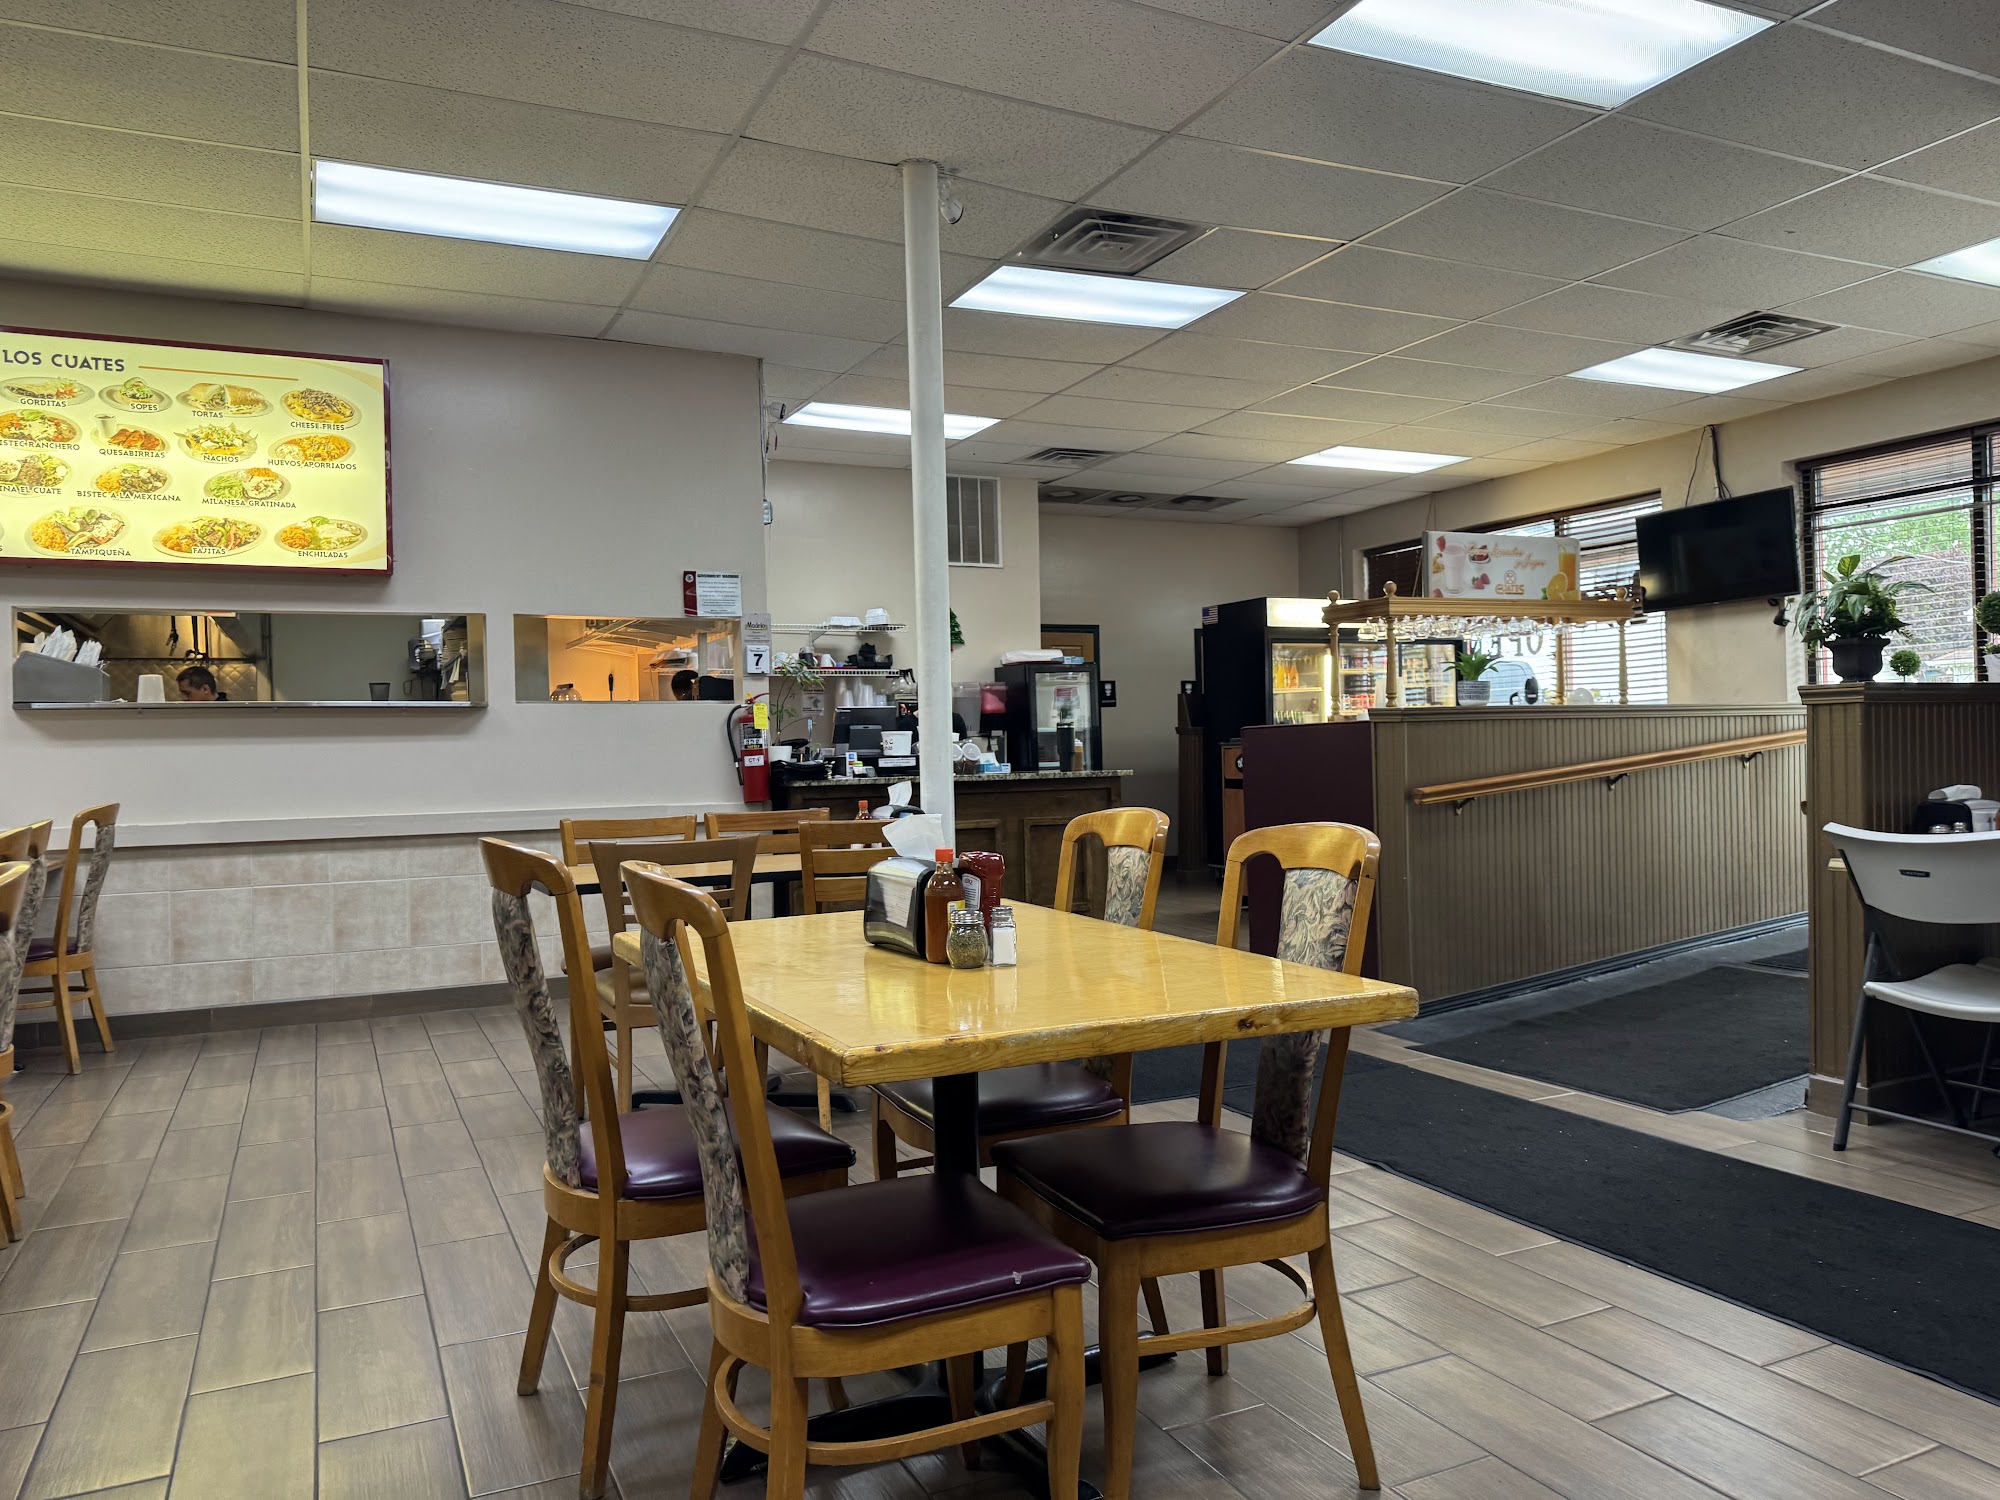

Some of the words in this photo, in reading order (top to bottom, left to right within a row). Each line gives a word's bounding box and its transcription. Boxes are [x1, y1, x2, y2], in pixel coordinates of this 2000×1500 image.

[3, 350, 42, 366] LOS
[51, 353, 125, 372] CUATES
[20, 398, 67, 408] GORDITAS
[130, 402, 158, 411] SOPES
[192, 410, 224, 419] TORTAS
[290, 421, 320, 430] CHEESE
[322, 423, 345, 431] FRIES
[29, 441, 80, 450] RANCHERO
[99, 448, 166, 459] QUESABIRRIAS
[203, 455, 239, 463] NACHOS
[267, 459, 301, 467] HUEVOS
[304, 461, 357, 470] APORRIADOS
[33, 487, 62, 495] CUATE
[77, 490, 108, 499] BISTEC
[111, 491, 117, 499] A
[119, 492, 131, 500] LA
[132, 493, 182, 502] MEXICANA
[202, 498, 246, 506] MILANESA
[249, 499, 297, 509] GRATINADA
[70, 547, 132, 557] TAMPIQUEÑA
[193, 546, 226, 555] FAJITAS
[297, 550, 349, 559] ENCHILADAS
[753, 653, 763, 667] 7
